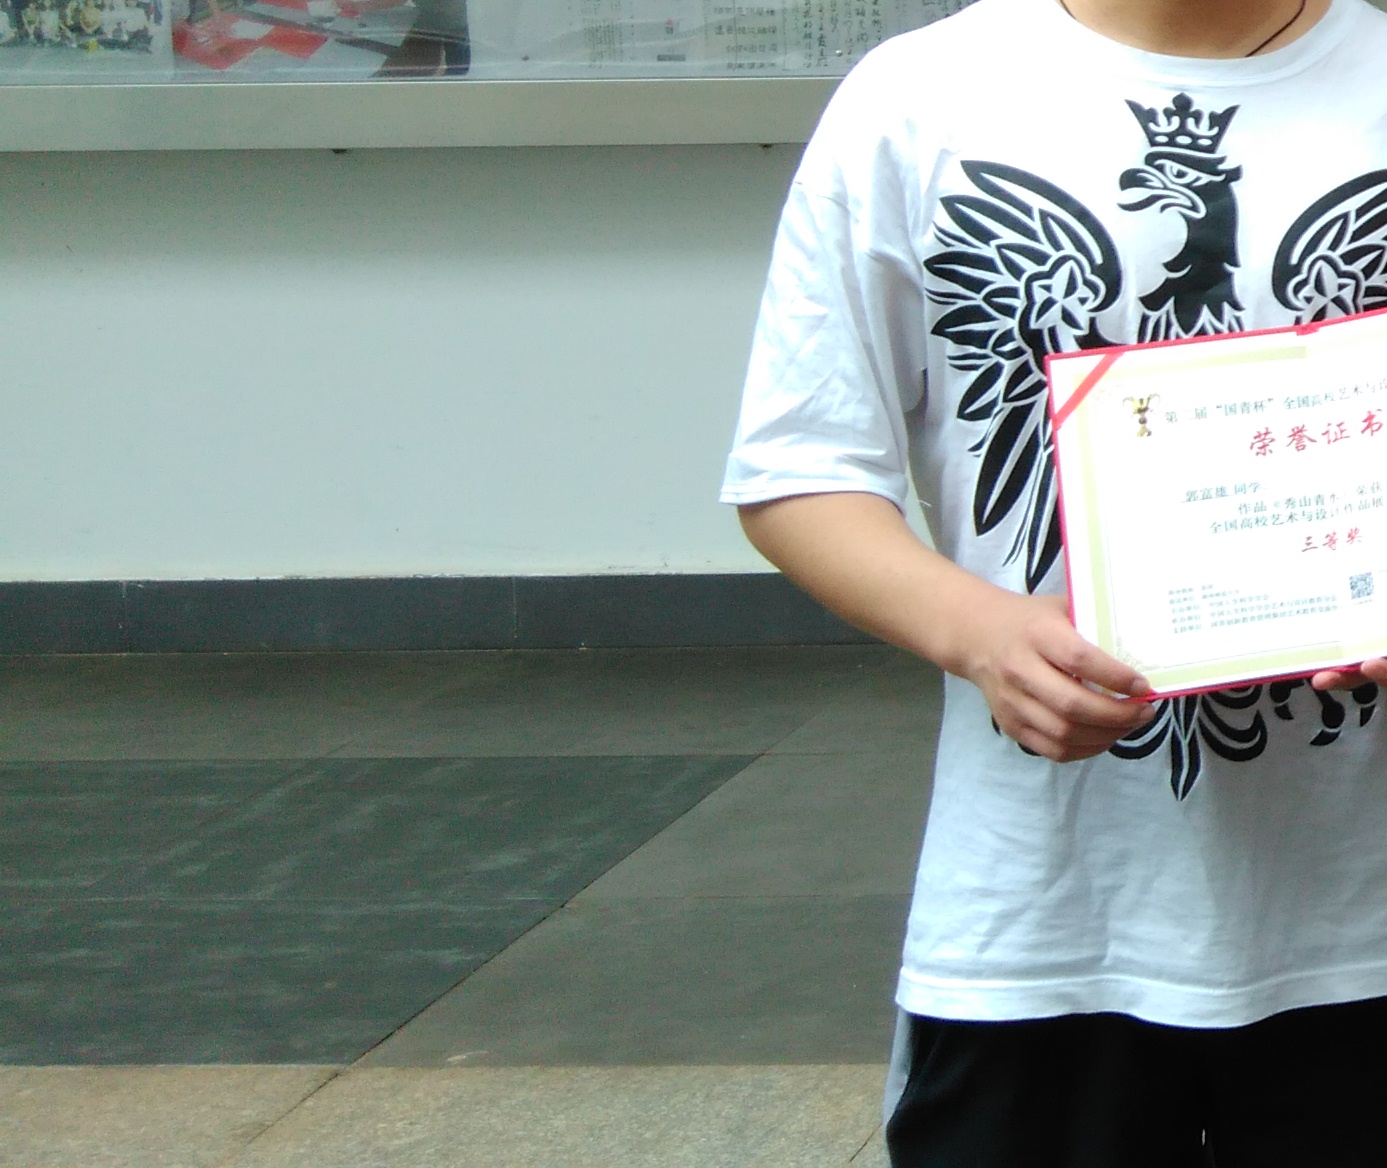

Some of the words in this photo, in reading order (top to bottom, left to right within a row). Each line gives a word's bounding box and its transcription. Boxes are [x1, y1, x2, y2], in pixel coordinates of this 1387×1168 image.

[1249, 408, 1384, 458] 荣誉证书
[1301, 525, 1364, 553] 三等奖
